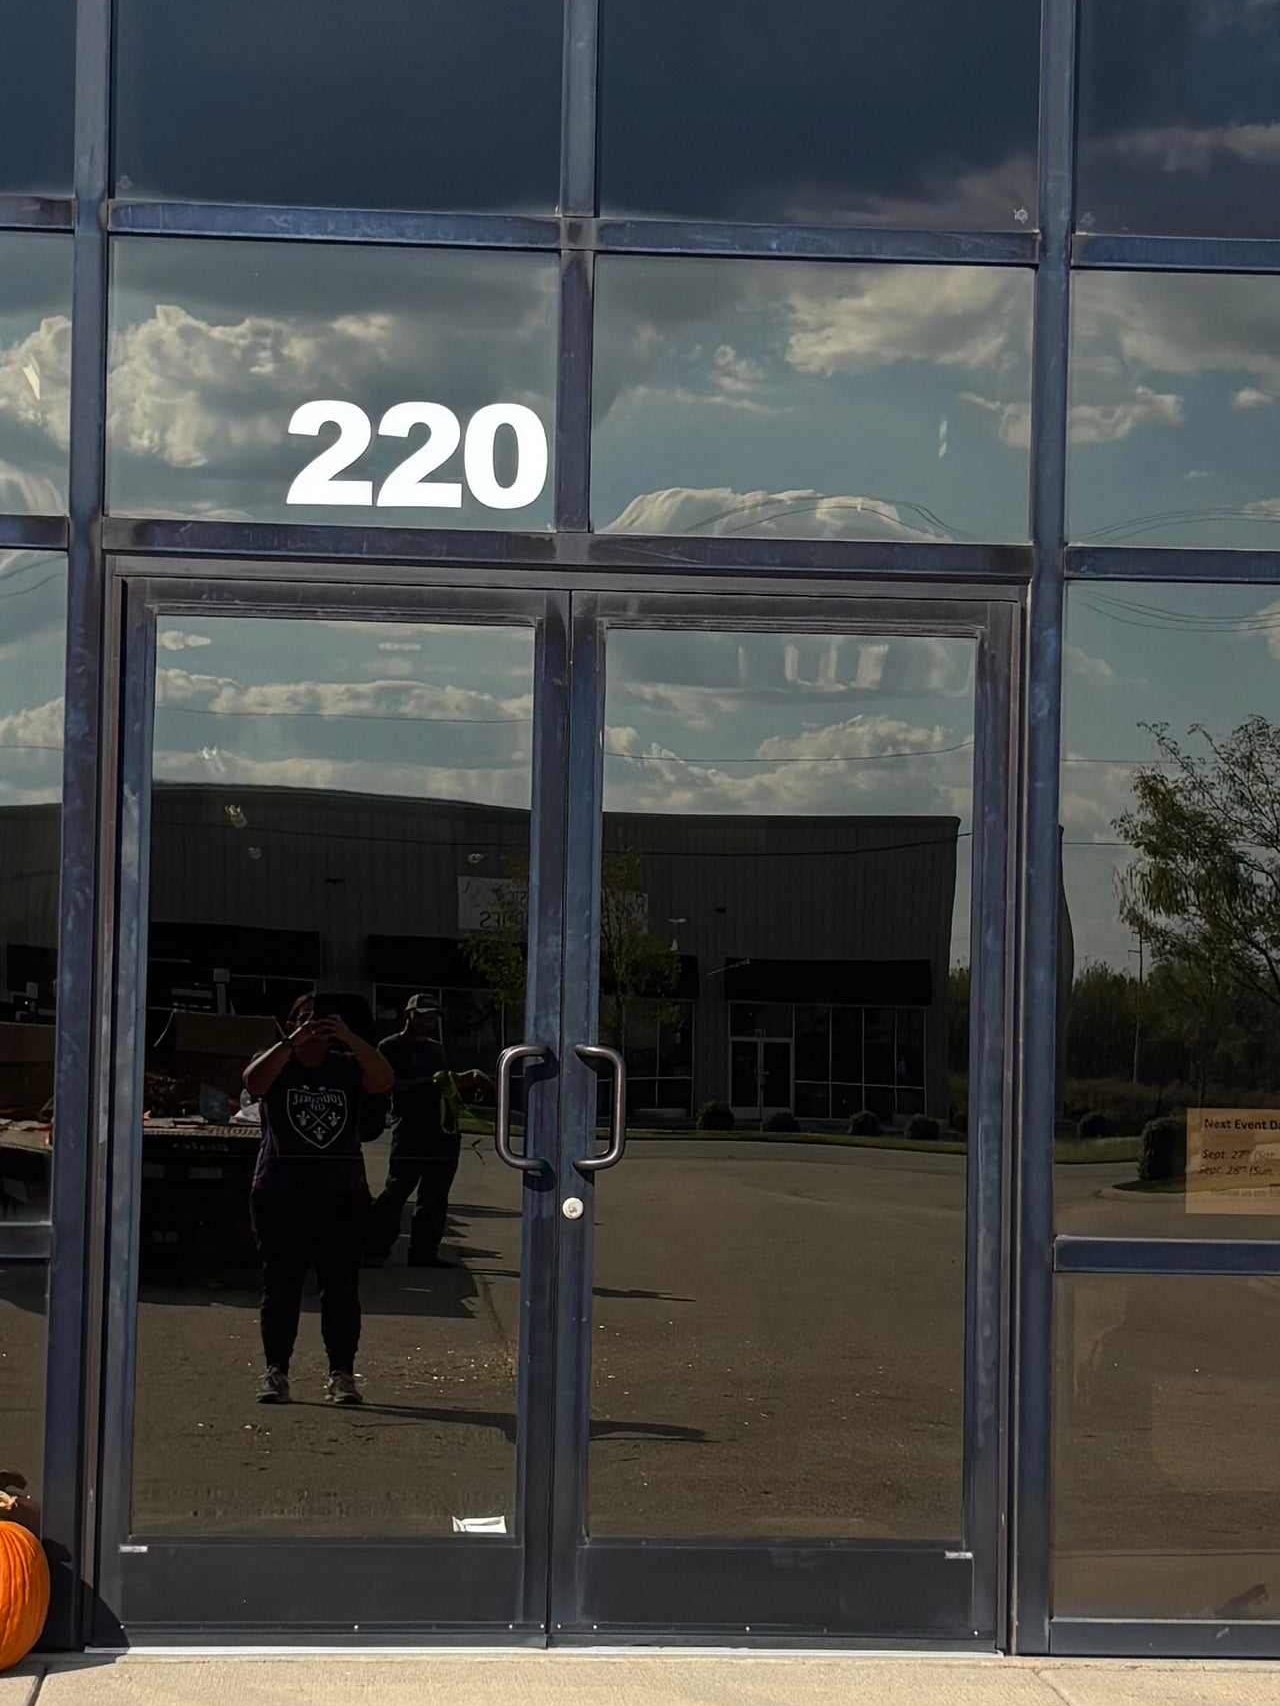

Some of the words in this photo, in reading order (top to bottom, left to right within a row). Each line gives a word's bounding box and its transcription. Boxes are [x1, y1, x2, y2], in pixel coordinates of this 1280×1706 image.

[286, 399, 548, 510] 220
[1204, 1118, 1231, 1130] Next
[1234, 1119, 1267, 1130] Event
